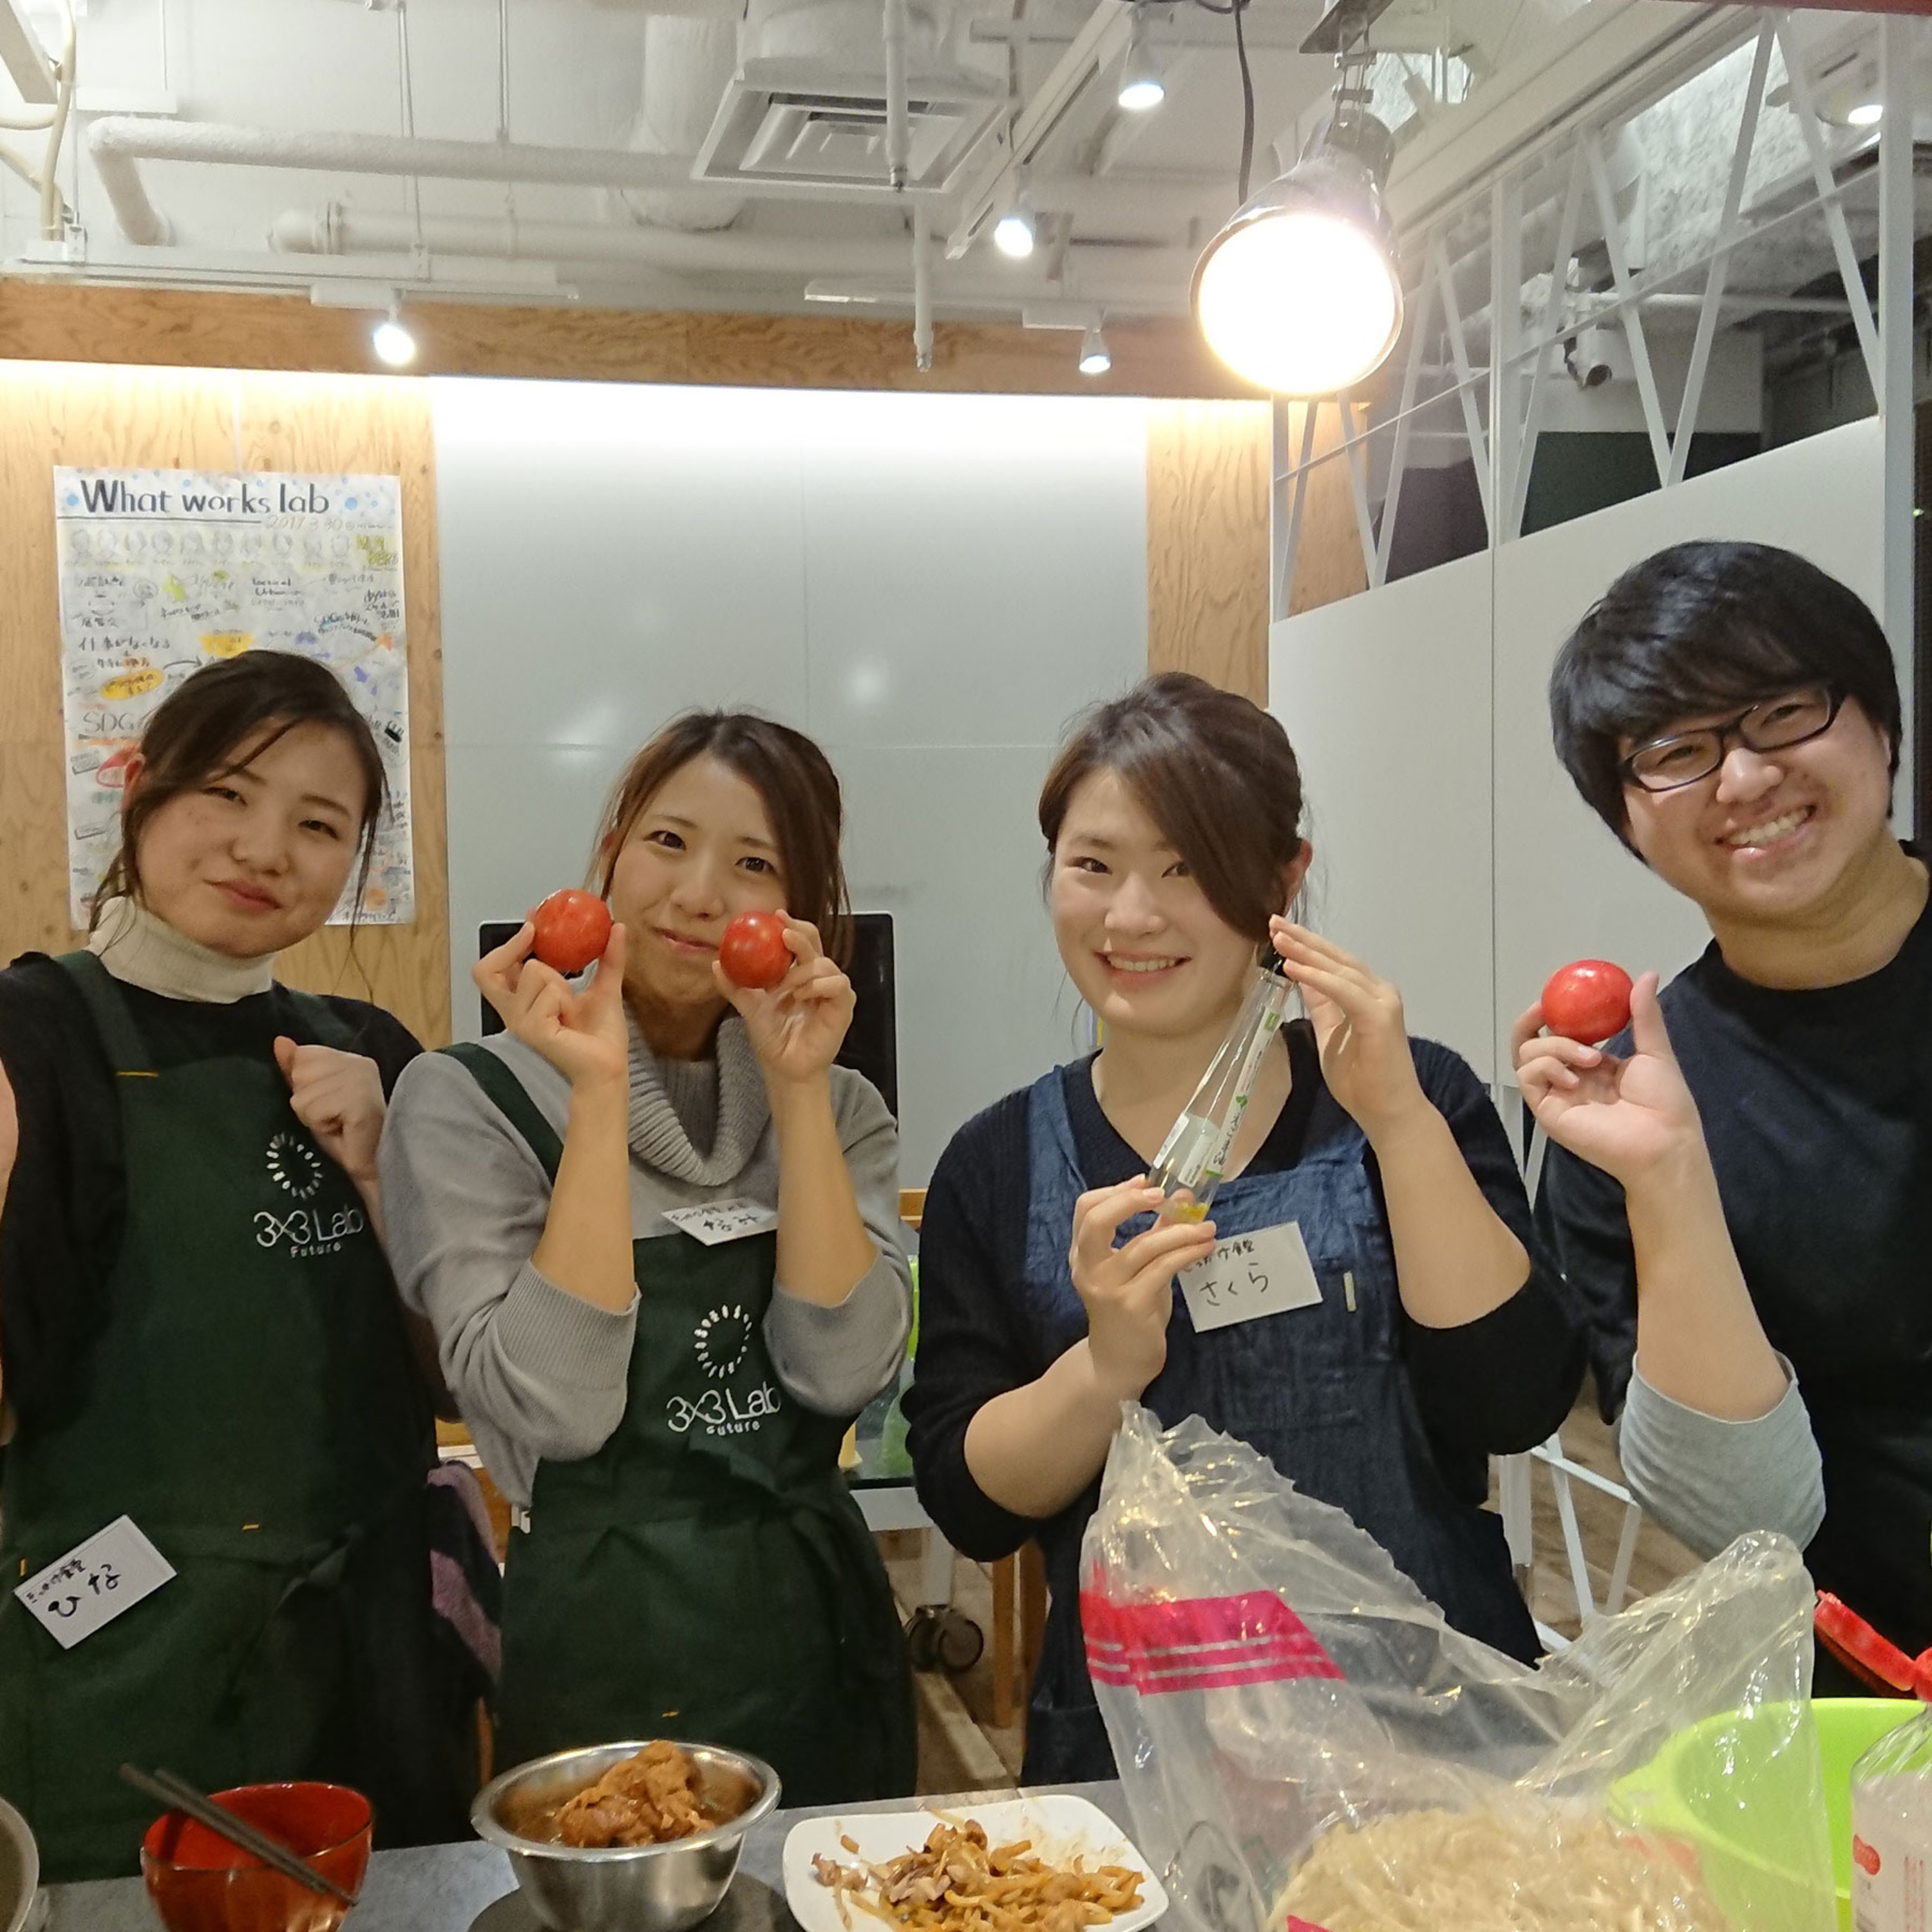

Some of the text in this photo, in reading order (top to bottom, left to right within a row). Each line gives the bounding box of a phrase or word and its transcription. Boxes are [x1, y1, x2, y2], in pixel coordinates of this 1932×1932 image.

[80, 479, 328, 514] What works lab
[1200, 1262, 1269, 1306] さくら
[48, 1564, 121, 1617] ひな
